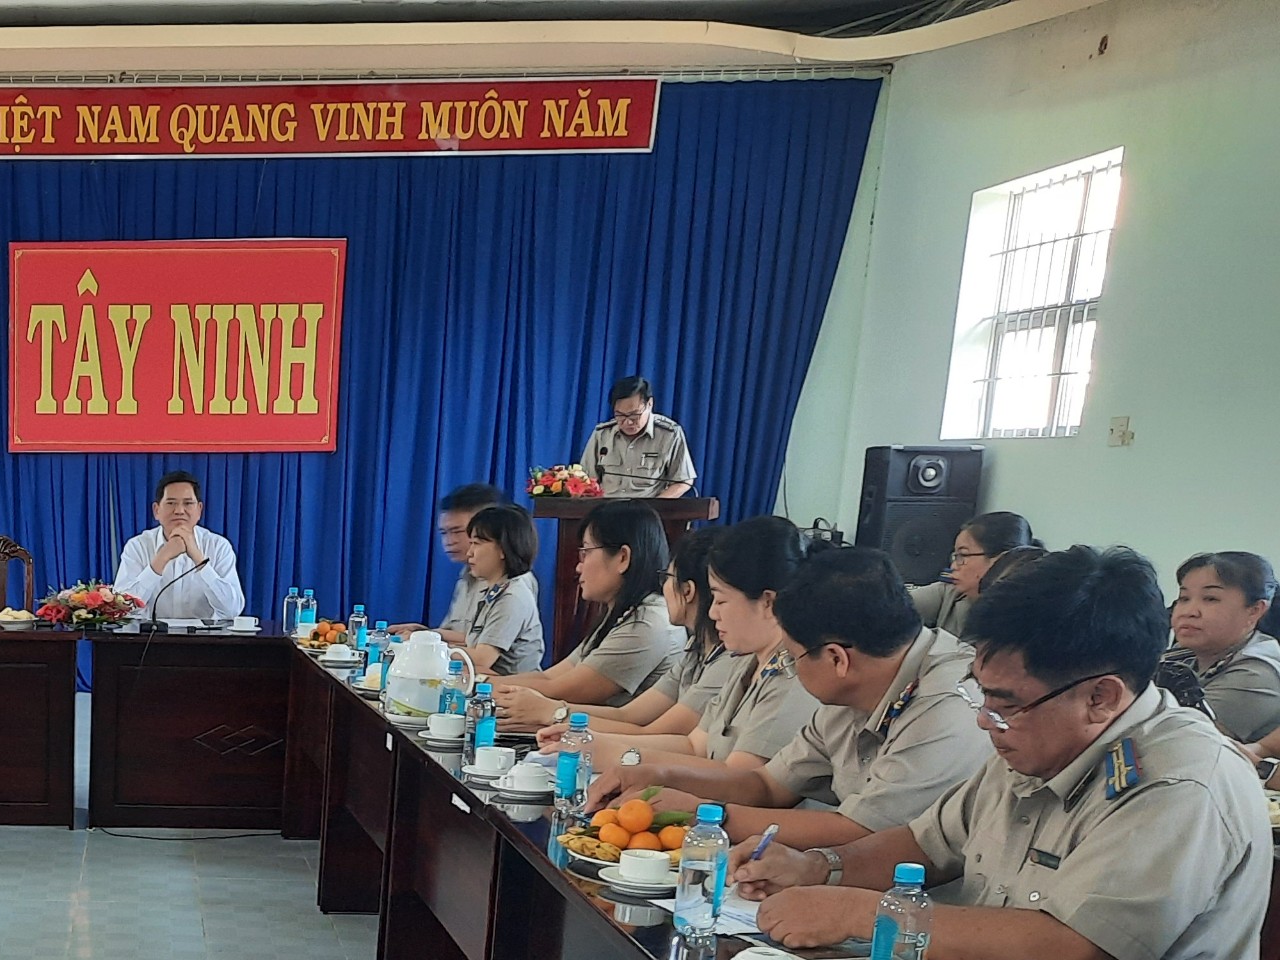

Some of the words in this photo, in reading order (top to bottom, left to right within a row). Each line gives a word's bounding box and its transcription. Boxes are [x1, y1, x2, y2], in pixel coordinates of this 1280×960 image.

[76, 104, 160, 144] NAM
[168, 102, 297, 153] QUANG
[310, 101, 407, 142] VINH
[418, 89, 528, 141] MUÔN
[539, 88, 631, 140] NĂM
[26, 268, 152, 415] TÂY
[167, 303, 324, 415] NINH
